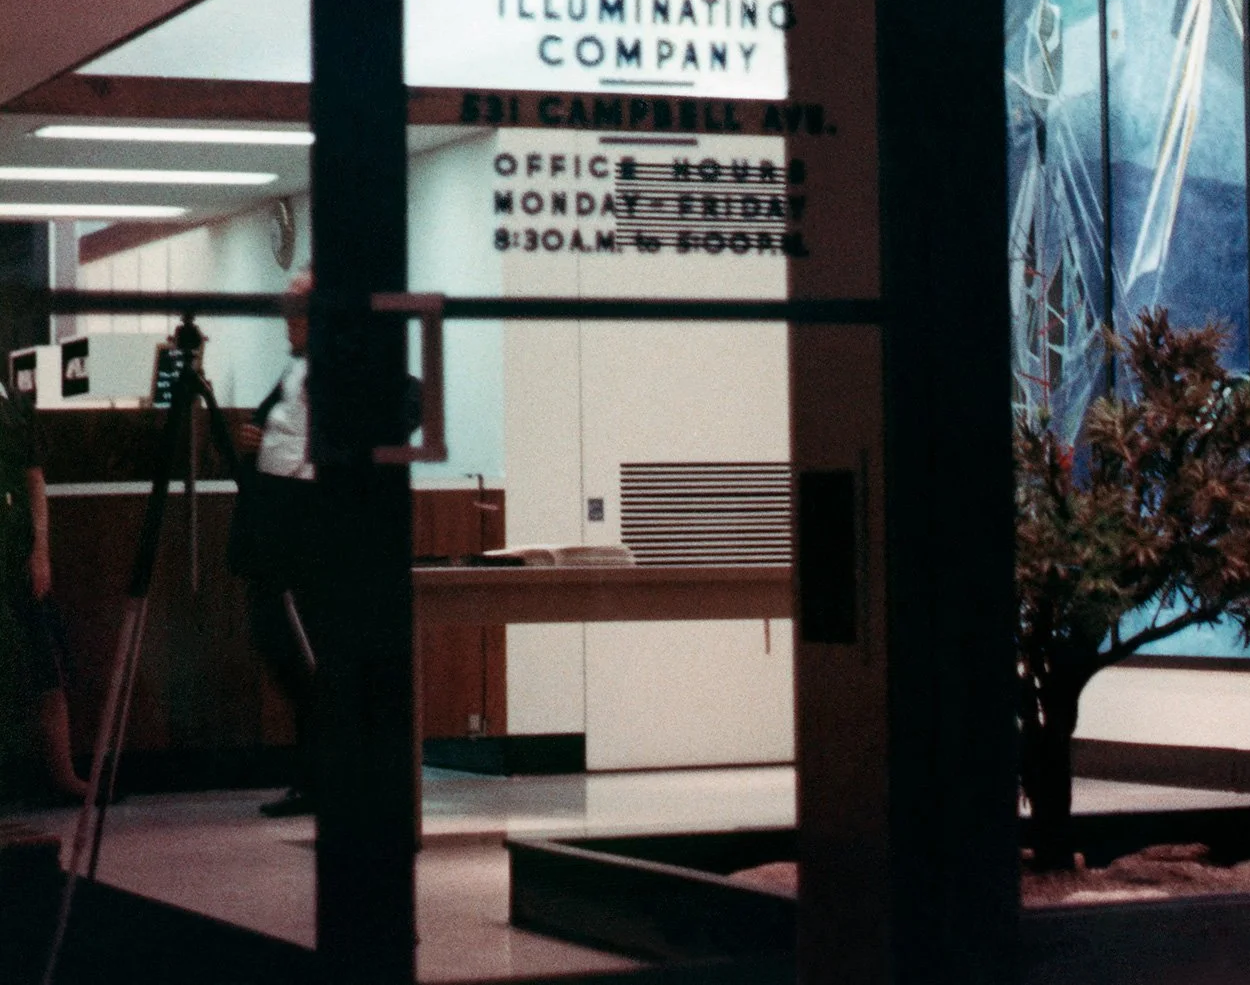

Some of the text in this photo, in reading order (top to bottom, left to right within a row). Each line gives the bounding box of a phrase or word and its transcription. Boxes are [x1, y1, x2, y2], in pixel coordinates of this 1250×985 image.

[538, 34, 758, 72] COMPANY
[537, 95, 740, 134] CAMPBELL
[763, 103, 837, 136] AVE.
[493, 153, 806, 186] OFFICE HOURS
[493, 190, 638, 217] MONDAY
[678, 194, 806, 221] FRIDAY
